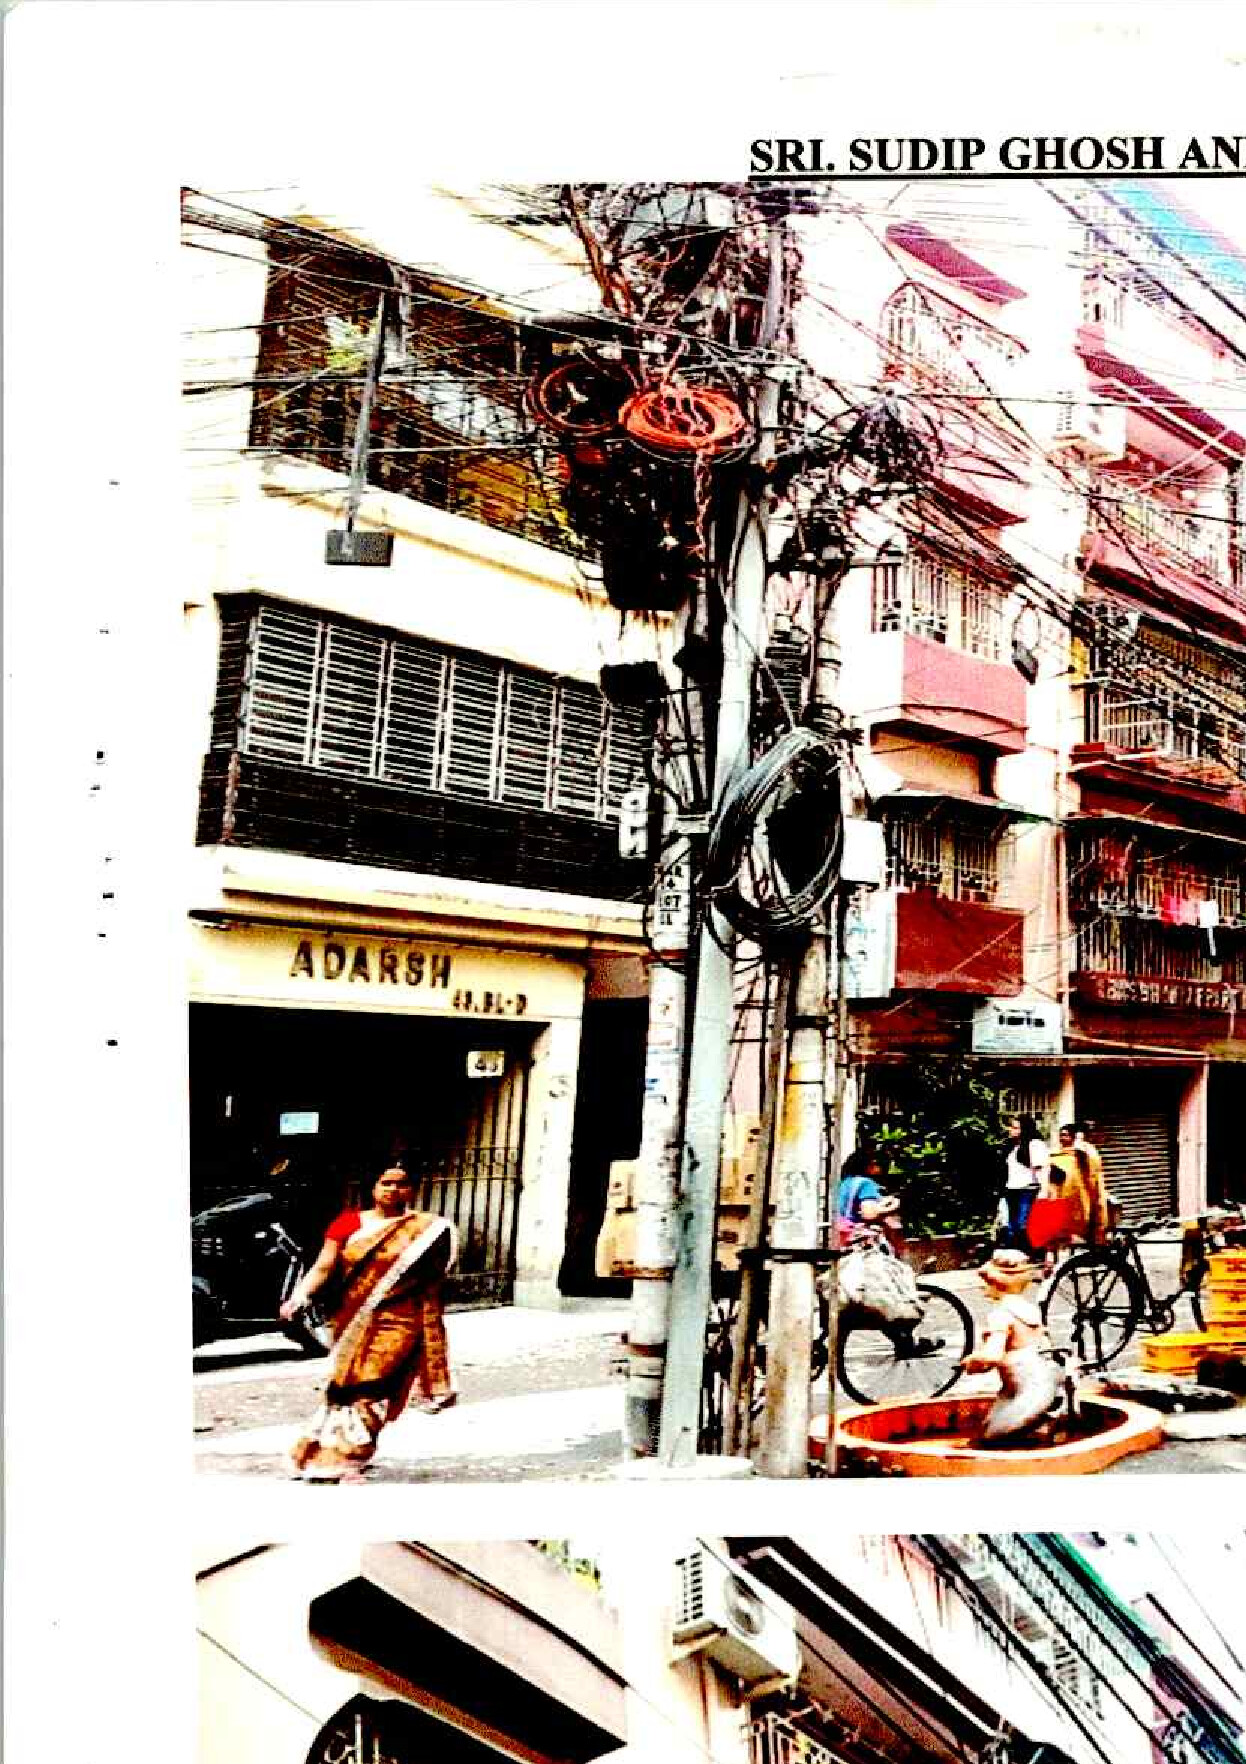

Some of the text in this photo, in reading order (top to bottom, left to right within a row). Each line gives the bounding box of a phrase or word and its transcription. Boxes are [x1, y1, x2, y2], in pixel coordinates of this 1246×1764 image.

[751, 139, 834, 170] SRI.
[850, 139, 985, 169] SUDIP
[1000, 137, 1164, 168] GHOSH
[289, 940, 453, 990] ADARSH
